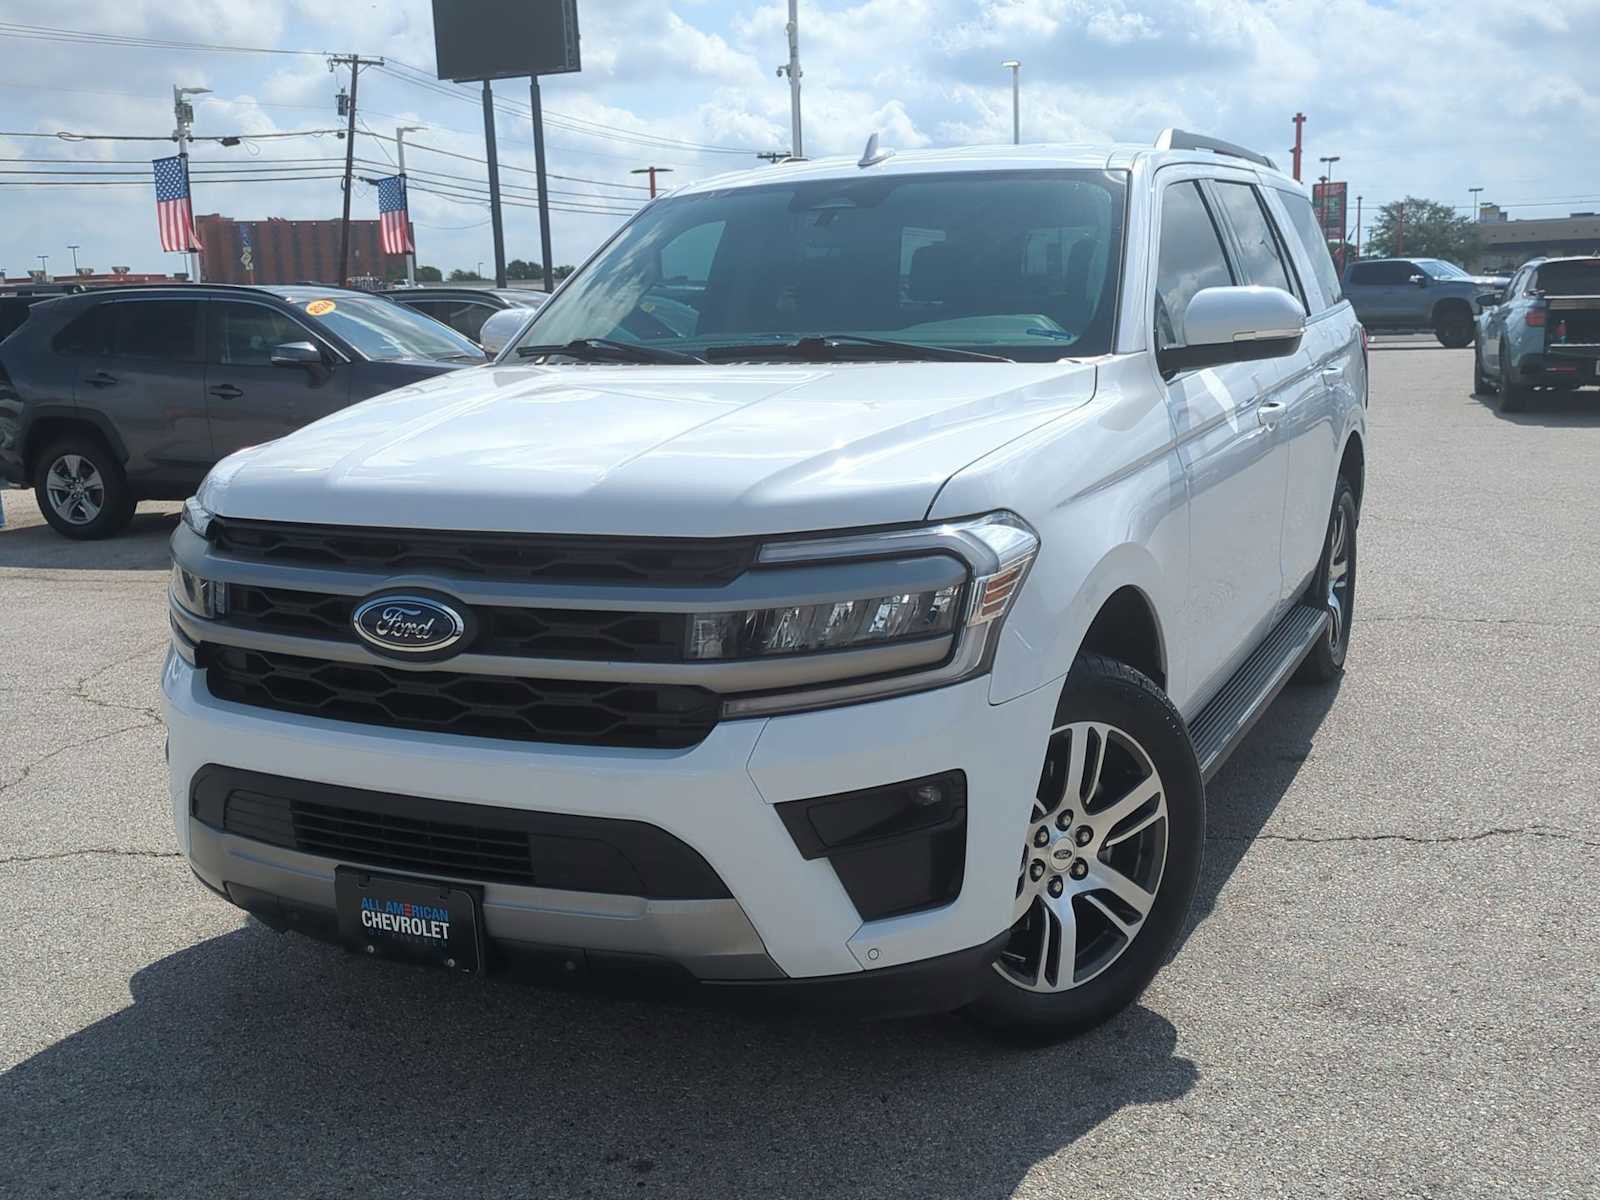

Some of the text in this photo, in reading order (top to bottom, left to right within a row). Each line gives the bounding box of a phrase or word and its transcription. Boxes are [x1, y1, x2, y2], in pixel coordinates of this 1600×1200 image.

[376, 606, 434, 639] Ford
[360, 897, 449, 921] ALL AMERICAN
[361, 910, 450, 939] CHEVROLET
